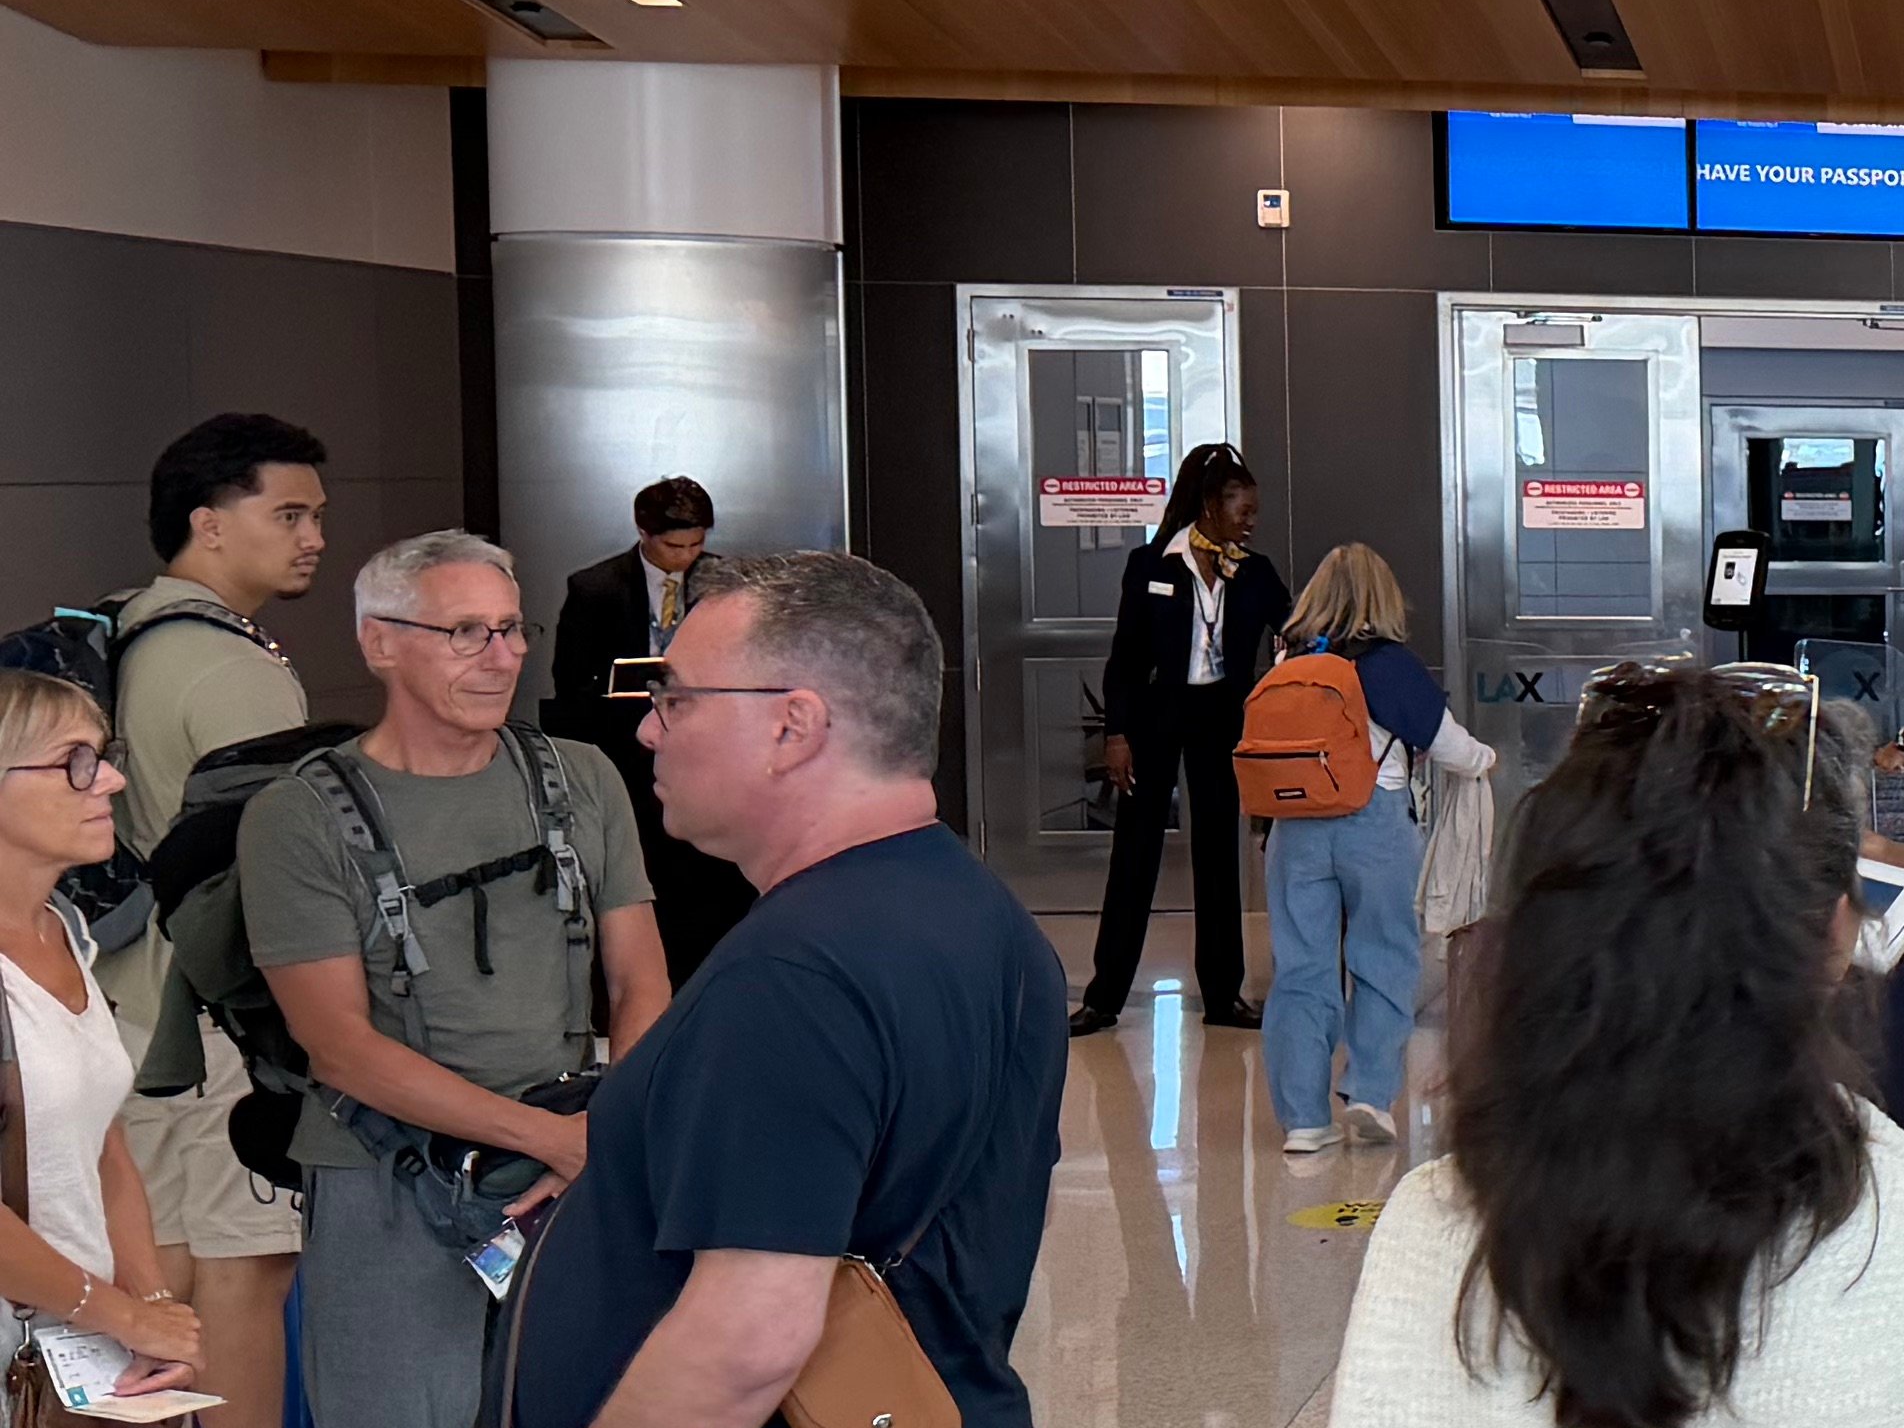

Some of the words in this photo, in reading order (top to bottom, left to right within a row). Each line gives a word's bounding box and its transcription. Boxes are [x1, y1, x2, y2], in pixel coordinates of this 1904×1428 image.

[1697, 163, 1751, 182] HAVE
[1755, 165, 1815, 184] YOUR
[1061, 480, 1118, 493] RESTRICTED
[1118, 481, 1145, 493] AREA
[1544, 483, 1598, 495] RESTRICTED
[1598, 484, 1623, 495] AREA
[1477, 671, 1545, 705] LAX
